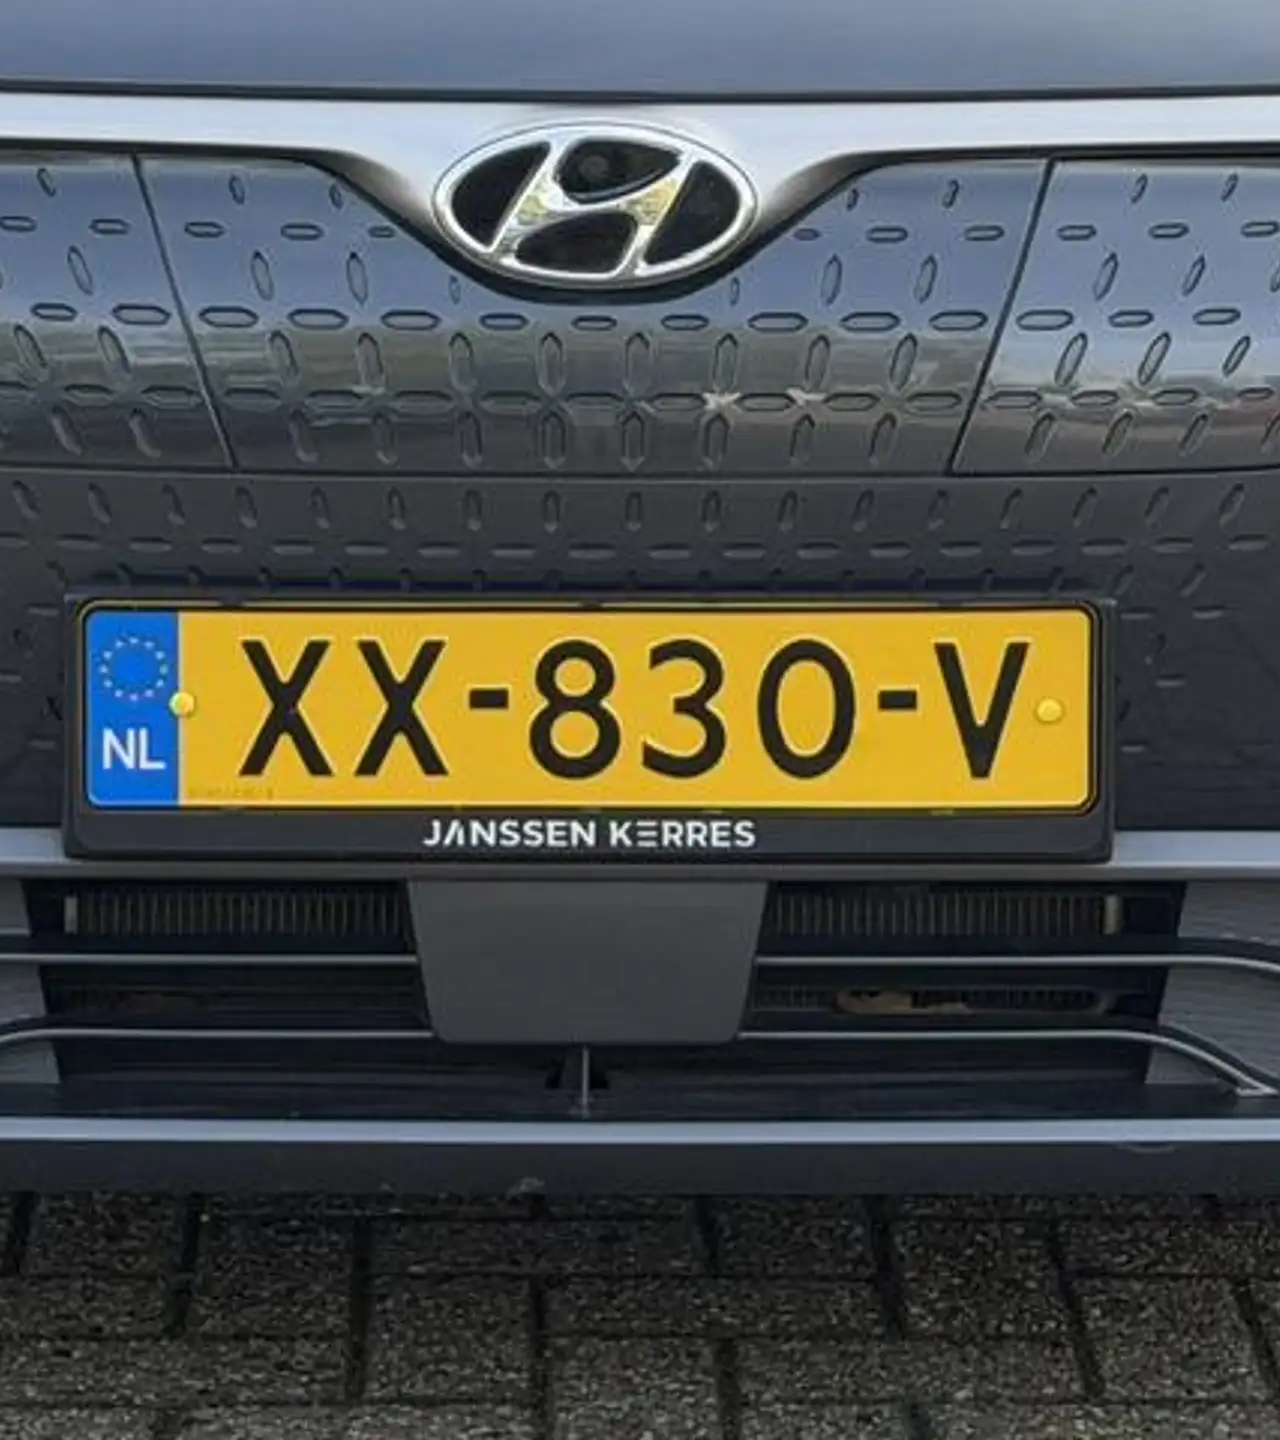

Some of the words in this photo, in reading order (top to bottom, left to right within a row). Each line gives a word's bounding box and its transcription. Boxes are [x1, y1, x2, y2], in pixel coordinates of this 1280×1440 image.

[238, 638, 1030, 780] XX-830-V
[102, 726, 167, 771] NL
[423, 819, 598, 849] JANSSEN
[609, 819, 757, 849] KERRES
